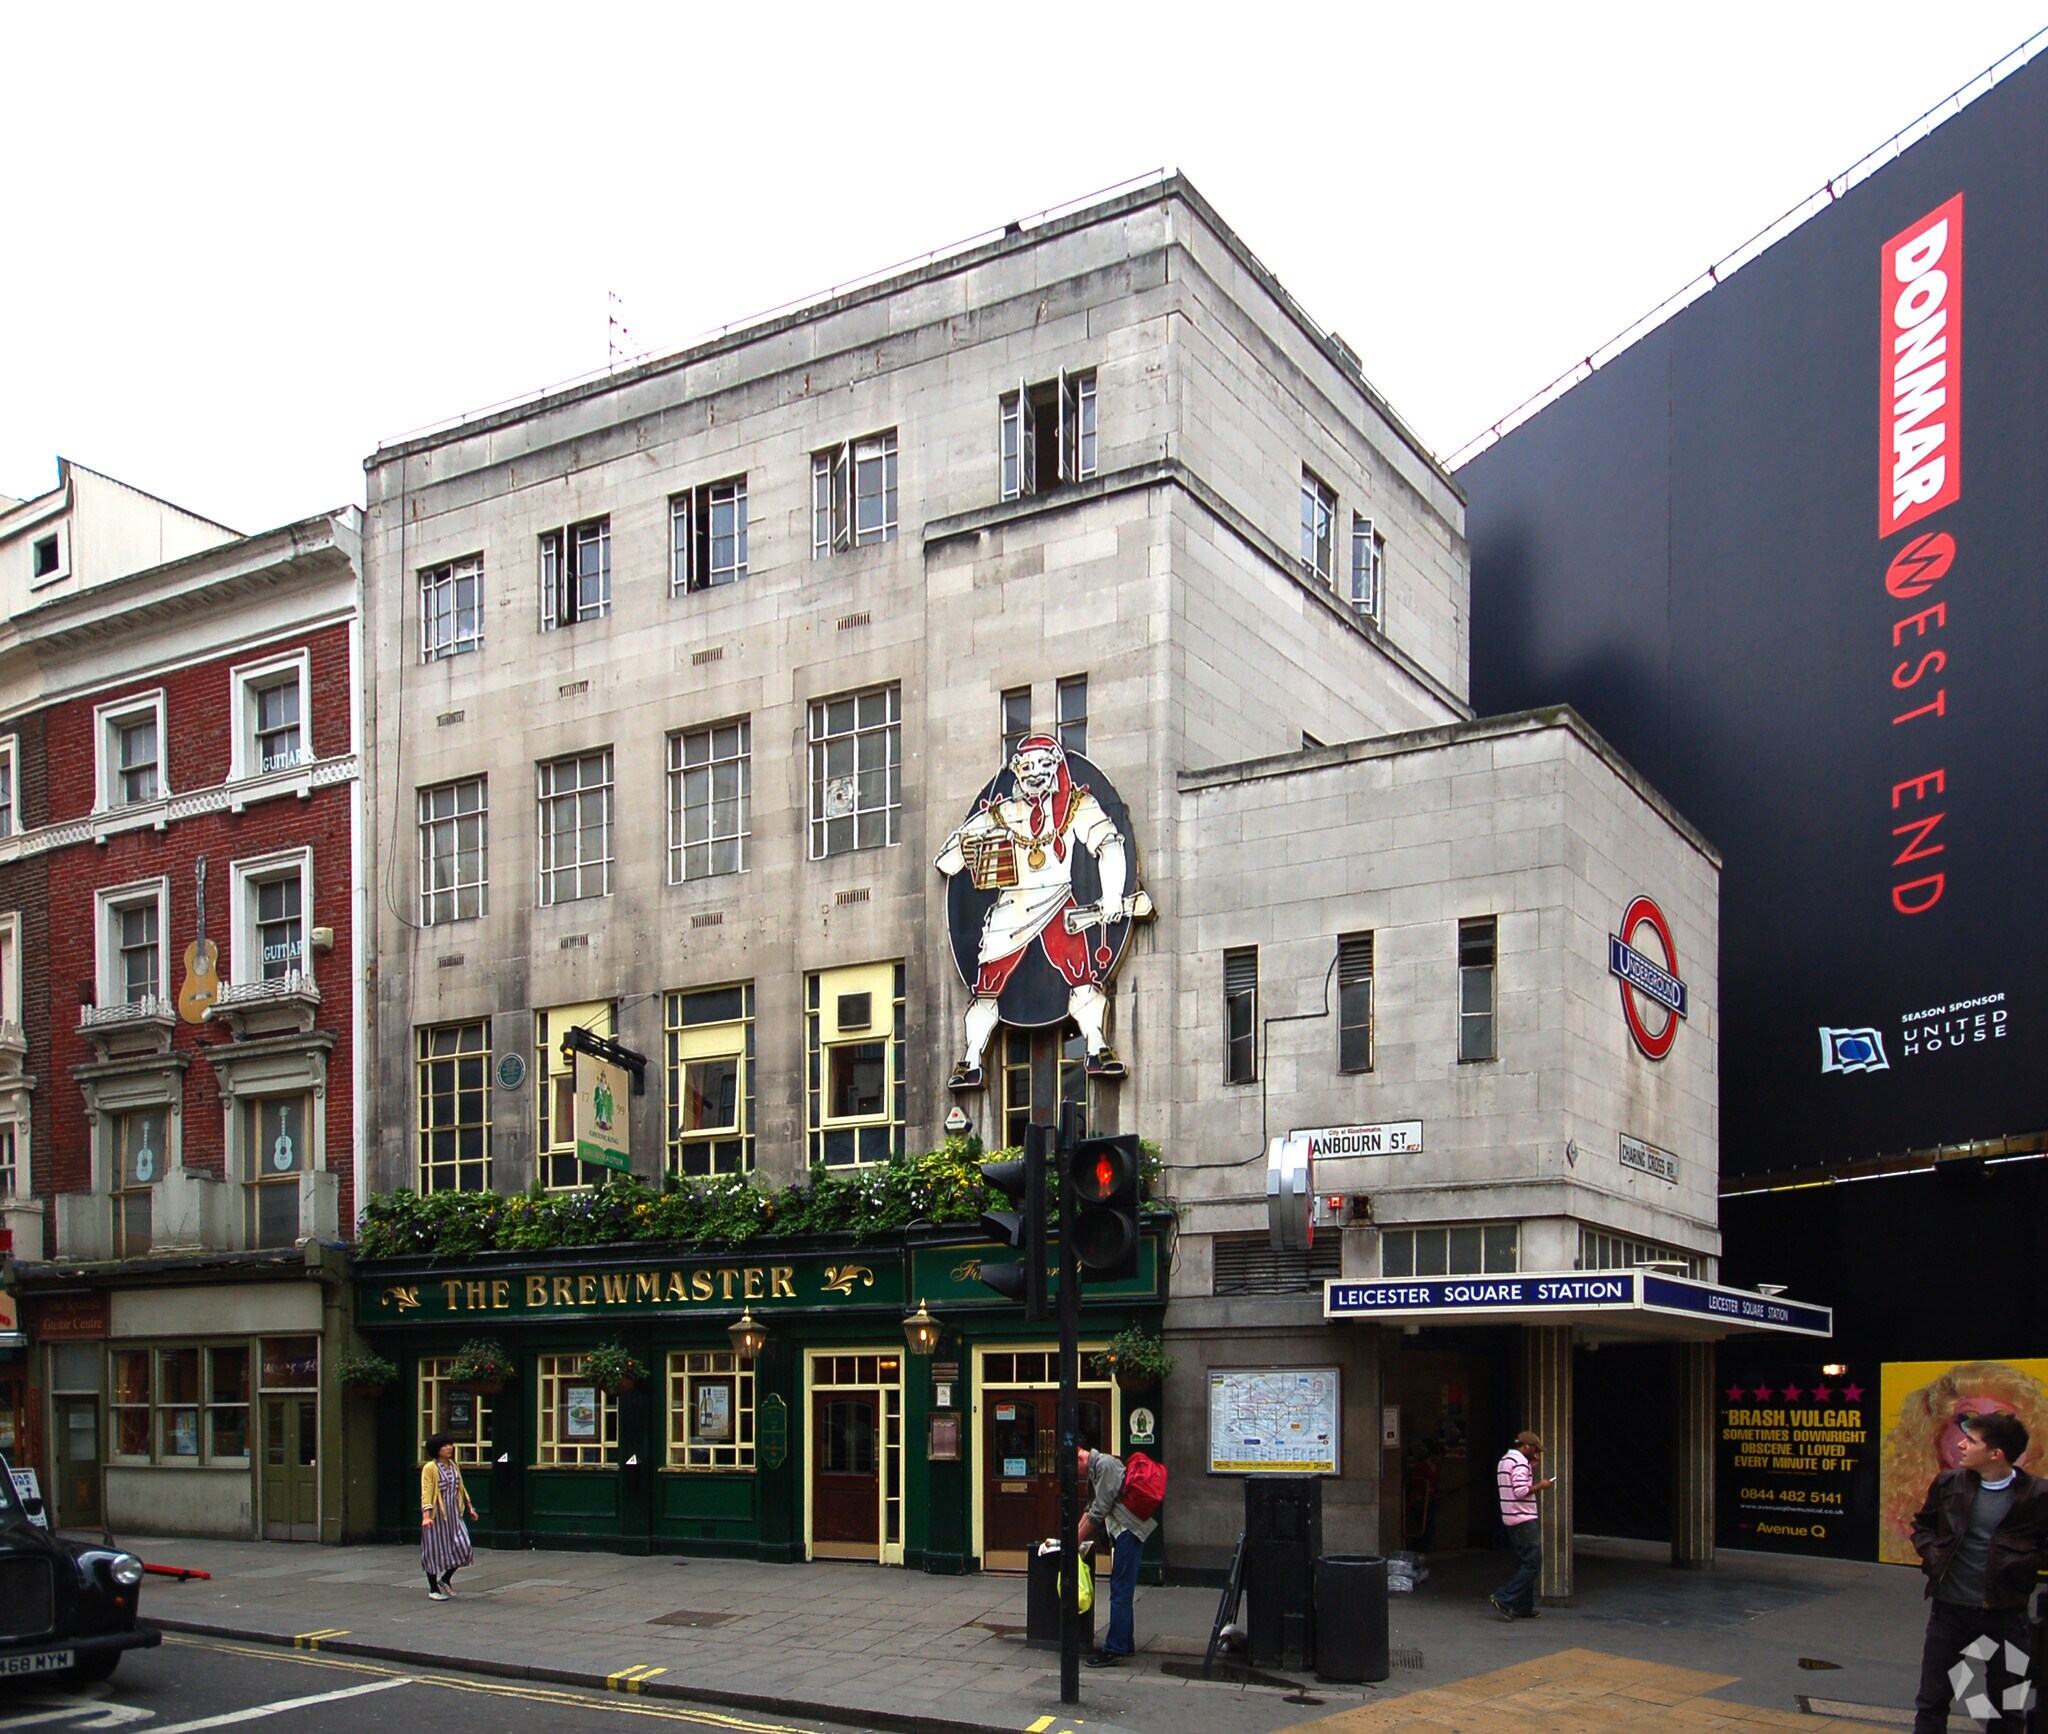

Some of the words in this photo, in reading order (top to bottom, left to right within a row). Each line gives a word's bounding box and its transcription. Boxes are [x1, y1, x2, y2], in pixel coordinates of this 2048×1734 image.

[1893, 217, 1949, 521] DONMAR
[1891, 768, 1946, 915] END
[1619, 945, 1681, 1008] UNDERGROUND
[1901, 1006, 1946, 1023] SEASON
[1949, 992, 2005, 1013] SPONSOR
[1903, 1010, 2008, 1041] UNITED
[1904, 1024, 2007, 1056] HOUSE
[1312, 1134, 1382, 1156] ANBOURN
[441, 1279, 510, 1310] THE
[525, 1265, 797, 1308] BREWMASTER
[1338, 1288, 1431, 1306] LEICESTER
[1444, 1284, 1522, 1302] SQUARE
[1537, 1282, 1623, 1300] STATION
[1708, 1295, 1739, 1314] LEICESTER
[1742, 1301, 1764, 1318] SQUARE
[1767, 1306, 1789, 1321] STATION
[73, 1318, 102, 1330] Centre
[1790, 1409, 1861, 1428] VULGAR
[1723, 1428, 1789, 1442] SOMETIMES
[1793, 1430, 1867, 1443] DOWNRIGHT
[1799, 1444, 1804, 1455] I
[1807, 1444, 1846, 1457] LOVED
[1734, 1456, 1769, 1468] EVERY
[1772, 1457, 1818, 1470] MINUTE
[1822, 1458, 1837, 1471] OF
[1740, 1488, 1774, 1500] 0844
[1778, 1490, 1806, 1502] 482
[1810, 1491, 1842, 1504] 5141
[1756, 1522, 1808, 1536] Avenue
[1810, 1524, 1826, 1538] Q
[35, 1652, 68, 1670] MYM
